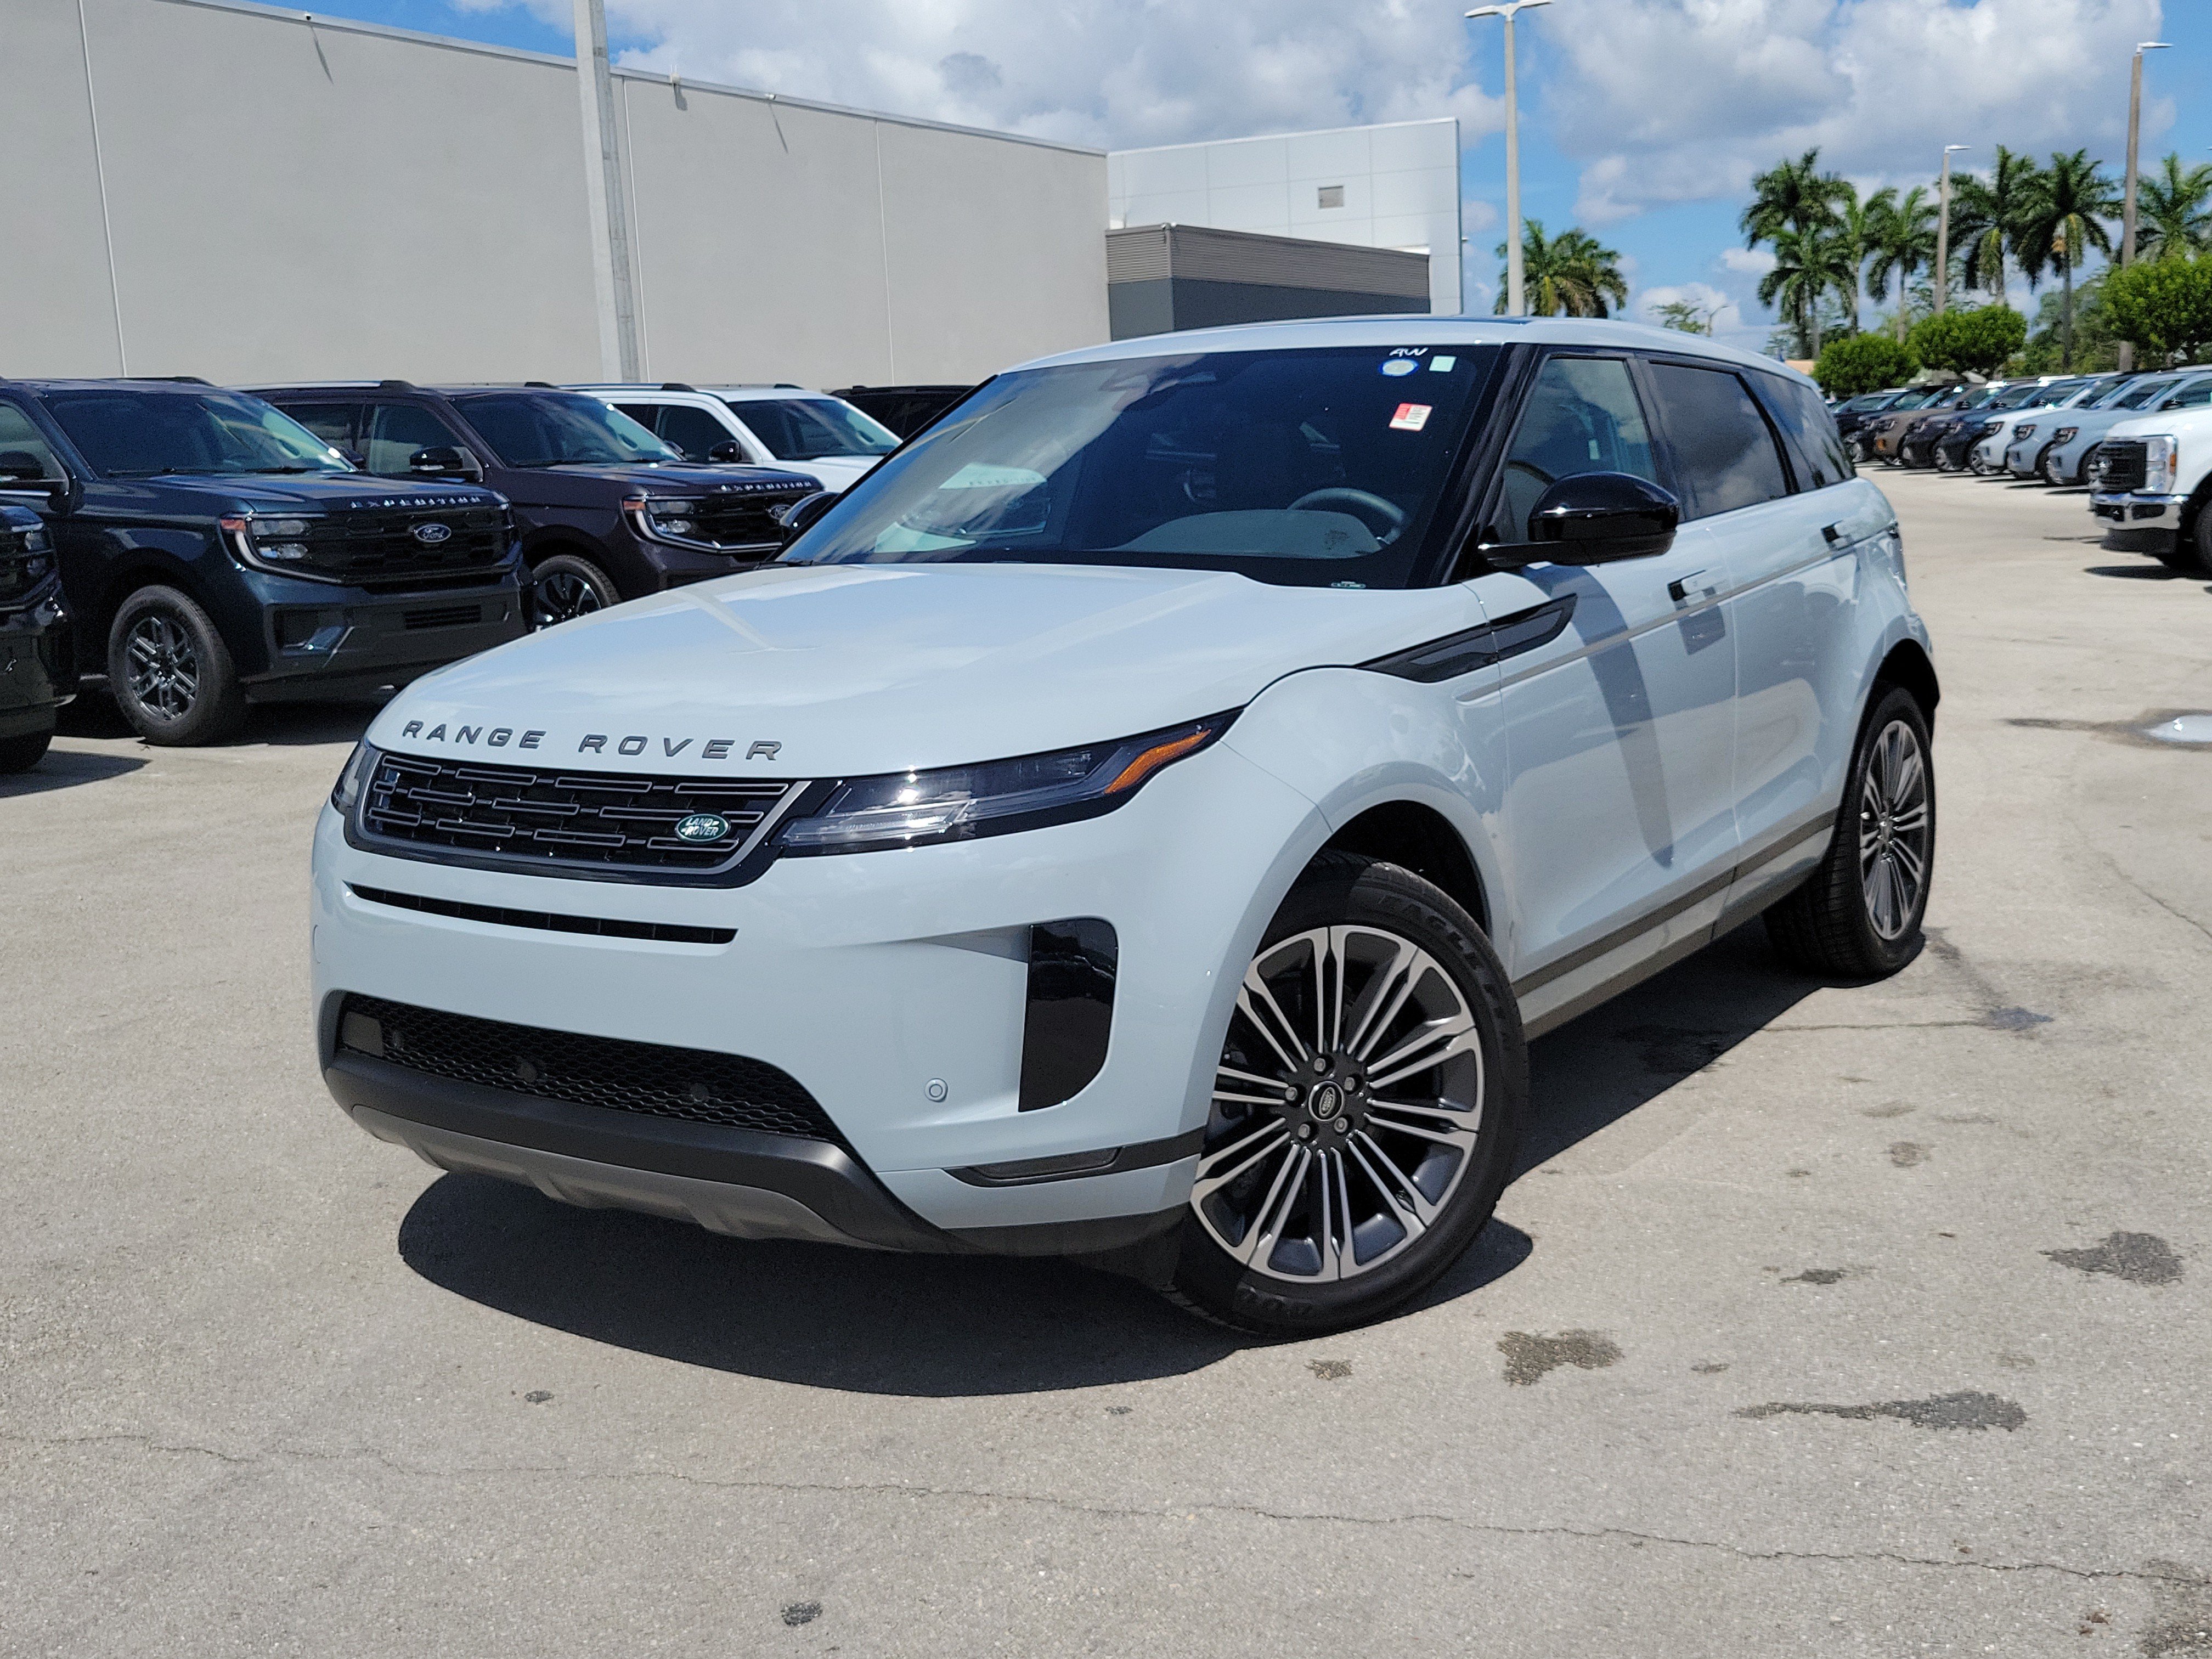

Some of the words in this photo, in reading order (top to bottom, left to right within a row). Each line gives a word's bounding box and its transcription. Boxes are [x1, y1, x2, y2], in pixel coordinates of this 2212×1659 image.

[402, 720, 546, 749] RANGE
[578, 733, 782, 761] ROVER
[686, 817, 714, 827] LAND
[684, 826, 719, 836] ROVER
